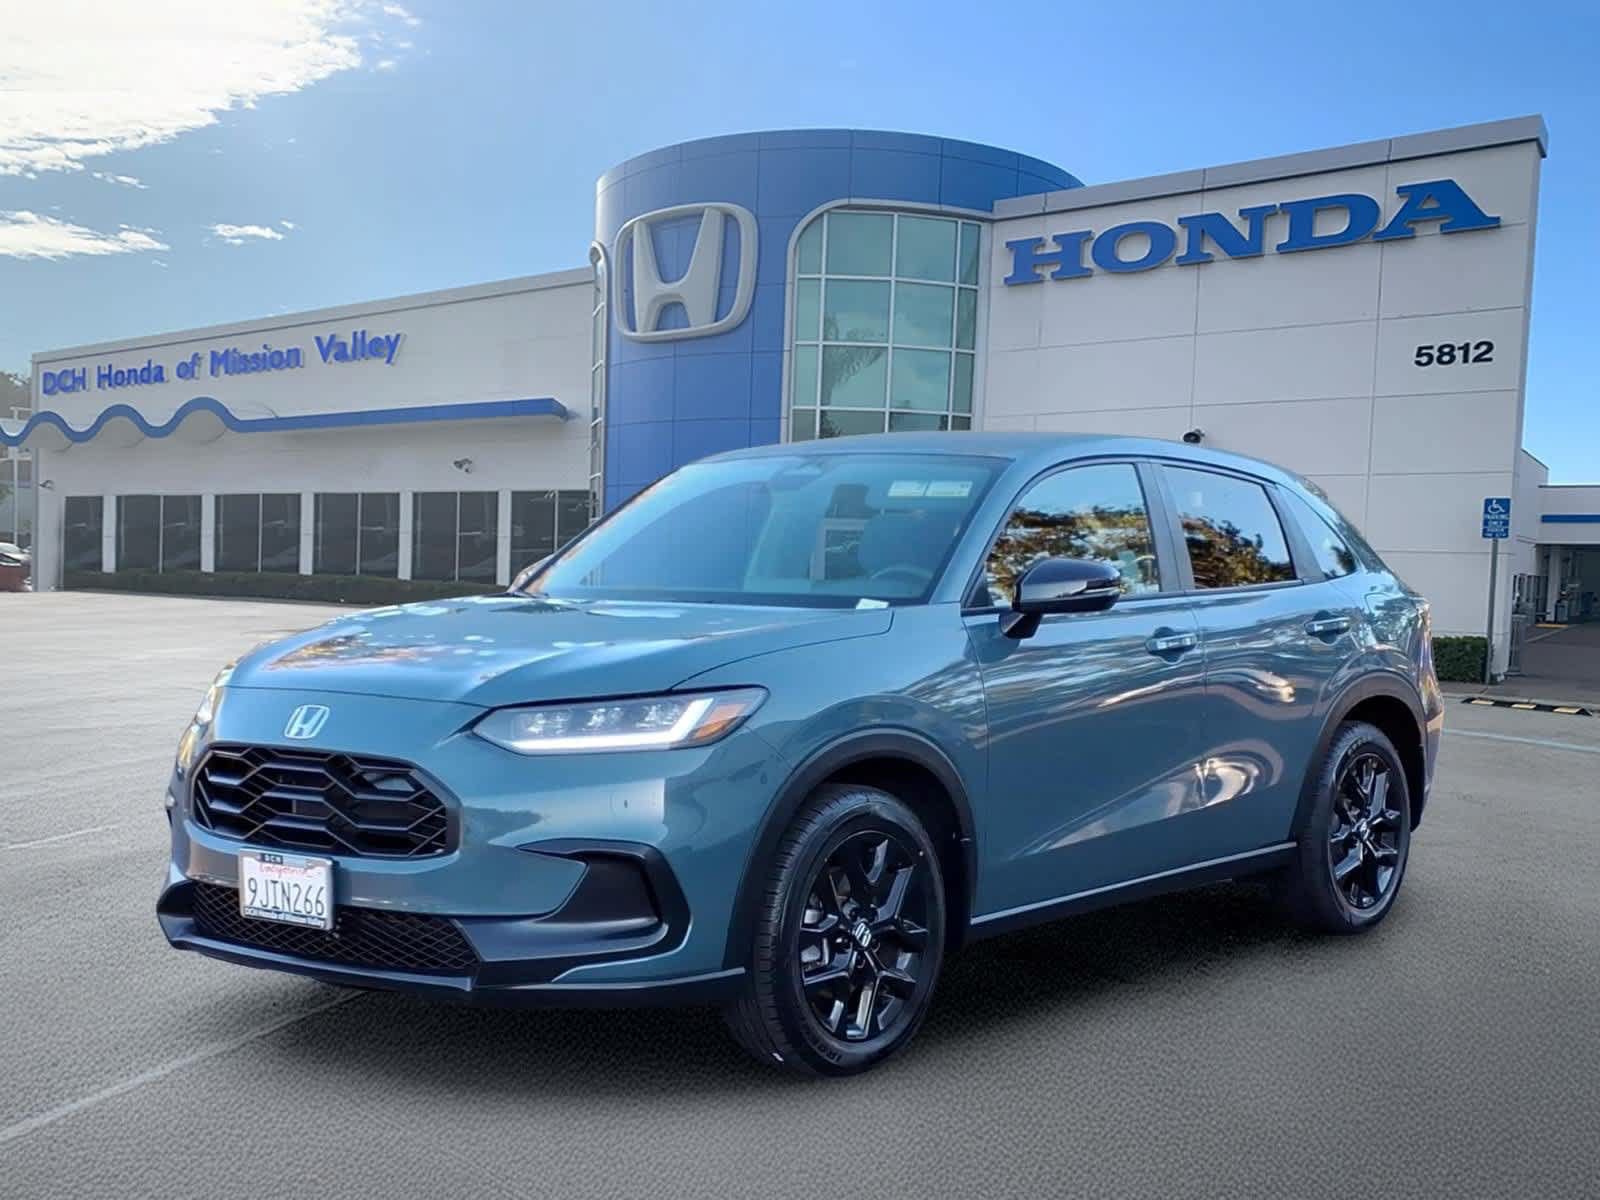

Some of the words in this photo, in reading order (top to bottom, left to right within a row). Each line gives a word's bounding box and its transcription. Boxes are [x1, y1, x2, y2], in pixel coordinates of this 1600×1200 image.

[1004, 179, 1502, 286] HONDA
[42, 367, 87, 396] DCH
[96, 359, 166, 389] Honda
[176, 352, 200, 379] of
[210, 343, 303, 377] Mission
[314, 330, 402, 365] Valley
[1413, 340, 1494, 367] 5812
[248, 877, 325, 916] 9JIN266
